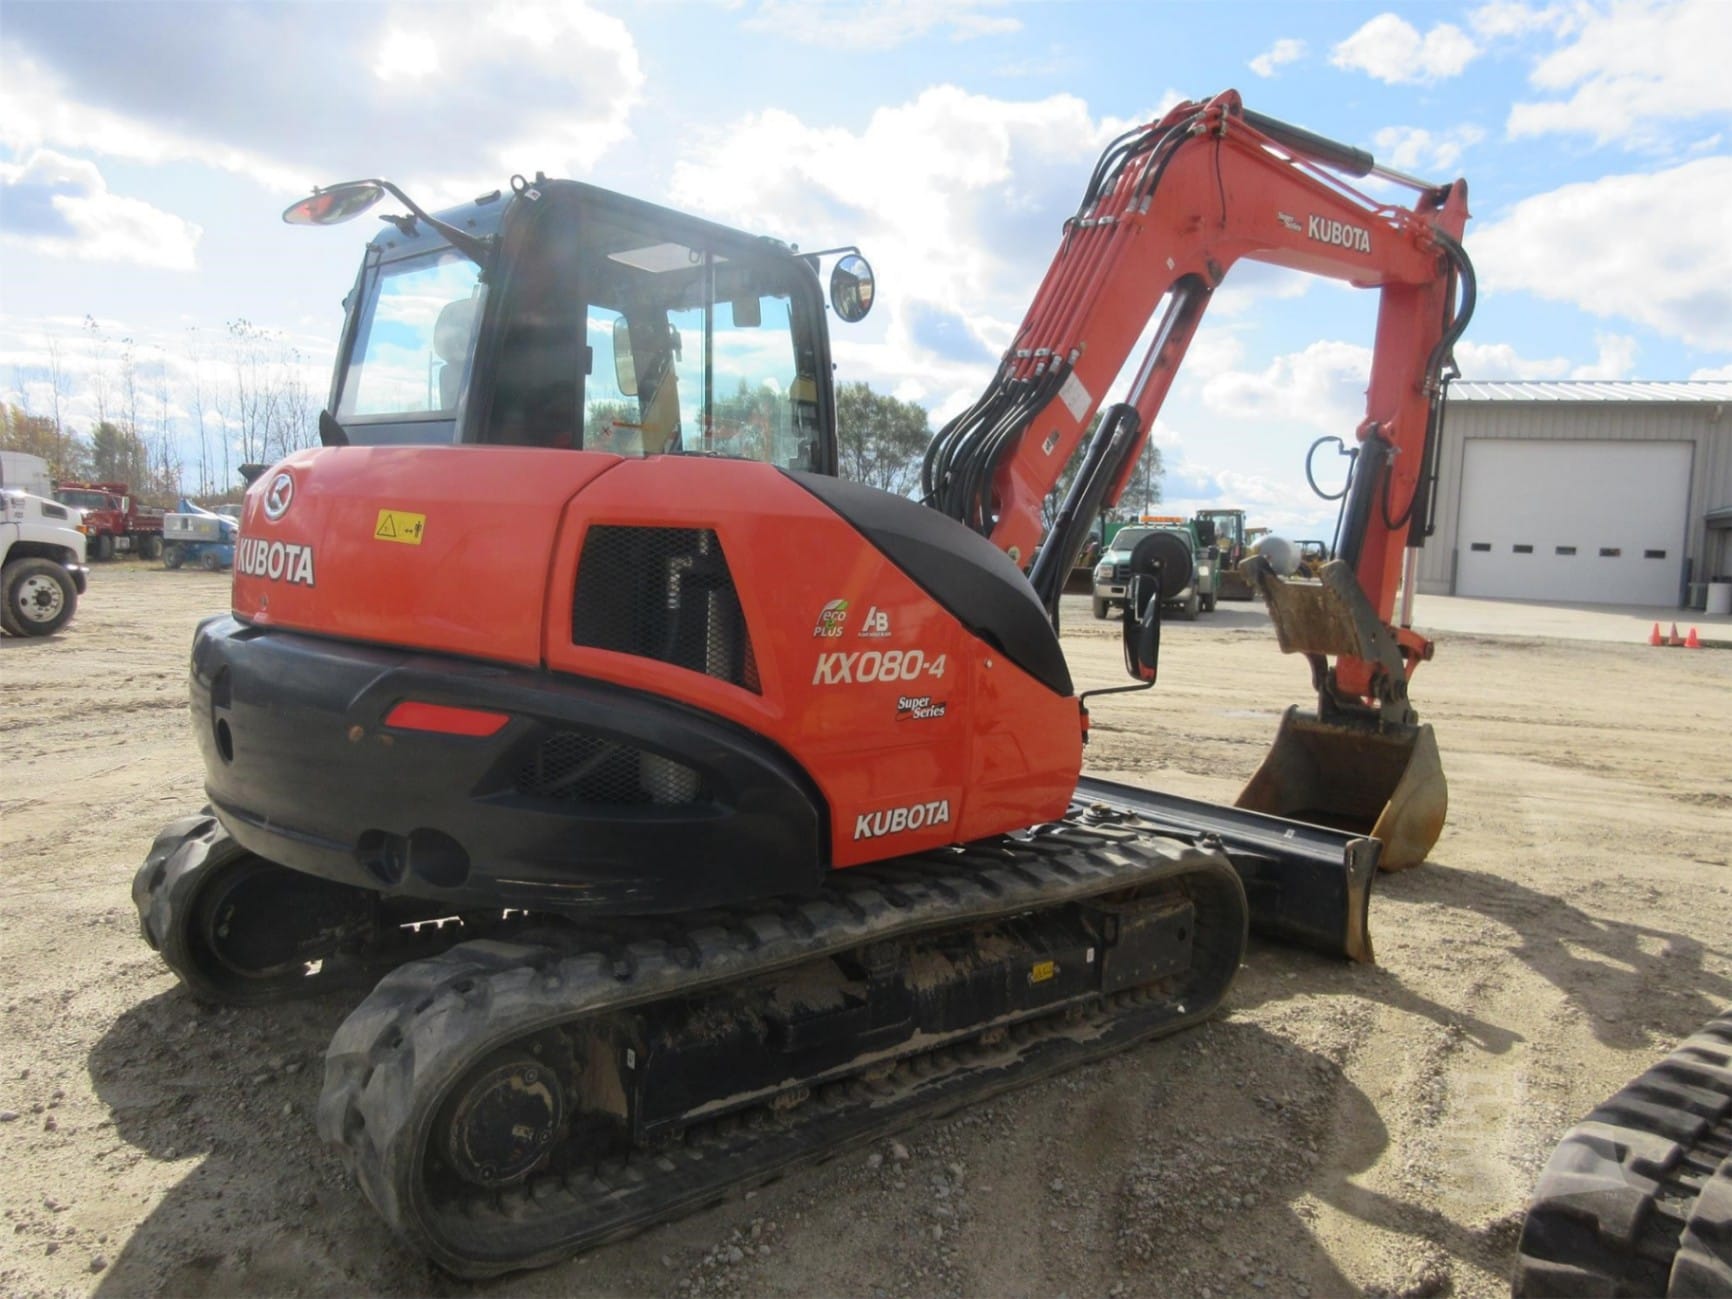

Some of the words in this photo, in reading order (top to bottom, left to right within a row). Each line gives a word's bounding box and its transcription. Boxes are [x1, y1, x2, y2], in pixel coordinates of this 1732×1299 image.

[1308, 215, 1370, 252] KUBOTA
[237, 537, 314, 585] KUBOTA
[813, 626, 843, 637] PLUS
[812, 650, 946, 685] KX080-4
[898, 696, 929, 710] Super
[912, 705, 945, 719] Series
[853, 800, 949, 839] KUBOTA
